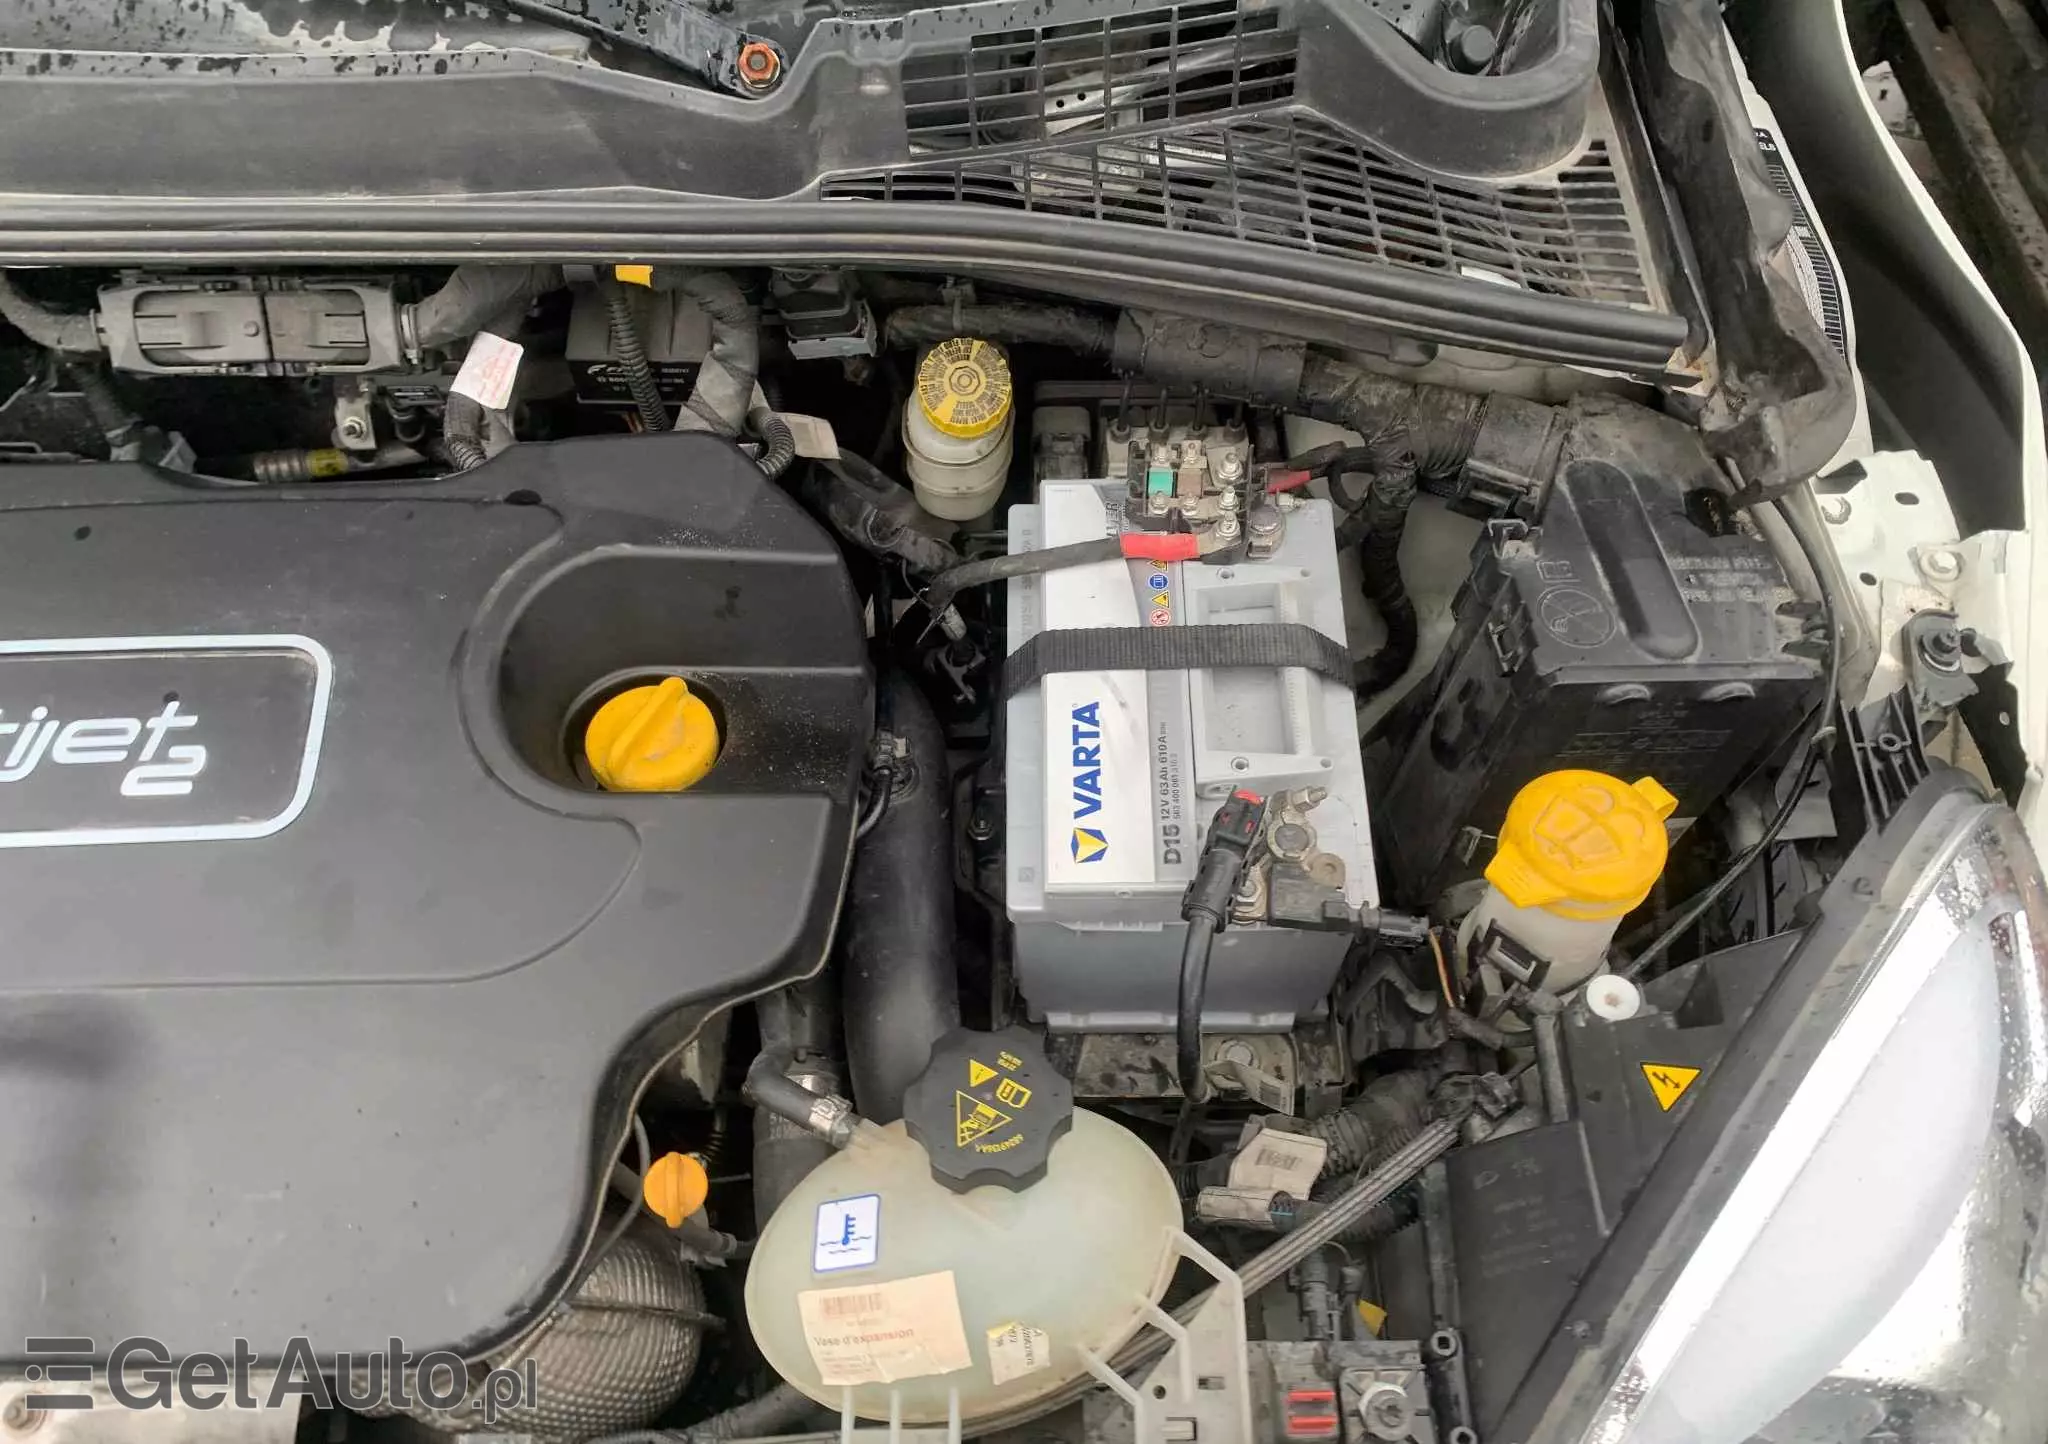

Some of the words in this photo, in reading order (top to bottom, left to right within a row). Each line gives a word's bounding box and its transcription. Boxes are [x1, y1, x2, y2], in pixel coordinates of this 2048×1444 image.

[0, 701, 198, 783] ijet
[1072, 701, 1102, 820] VARTA
[1160, 799, 1170, 820] 12V
[1162, 824, 1182, 864] D15
